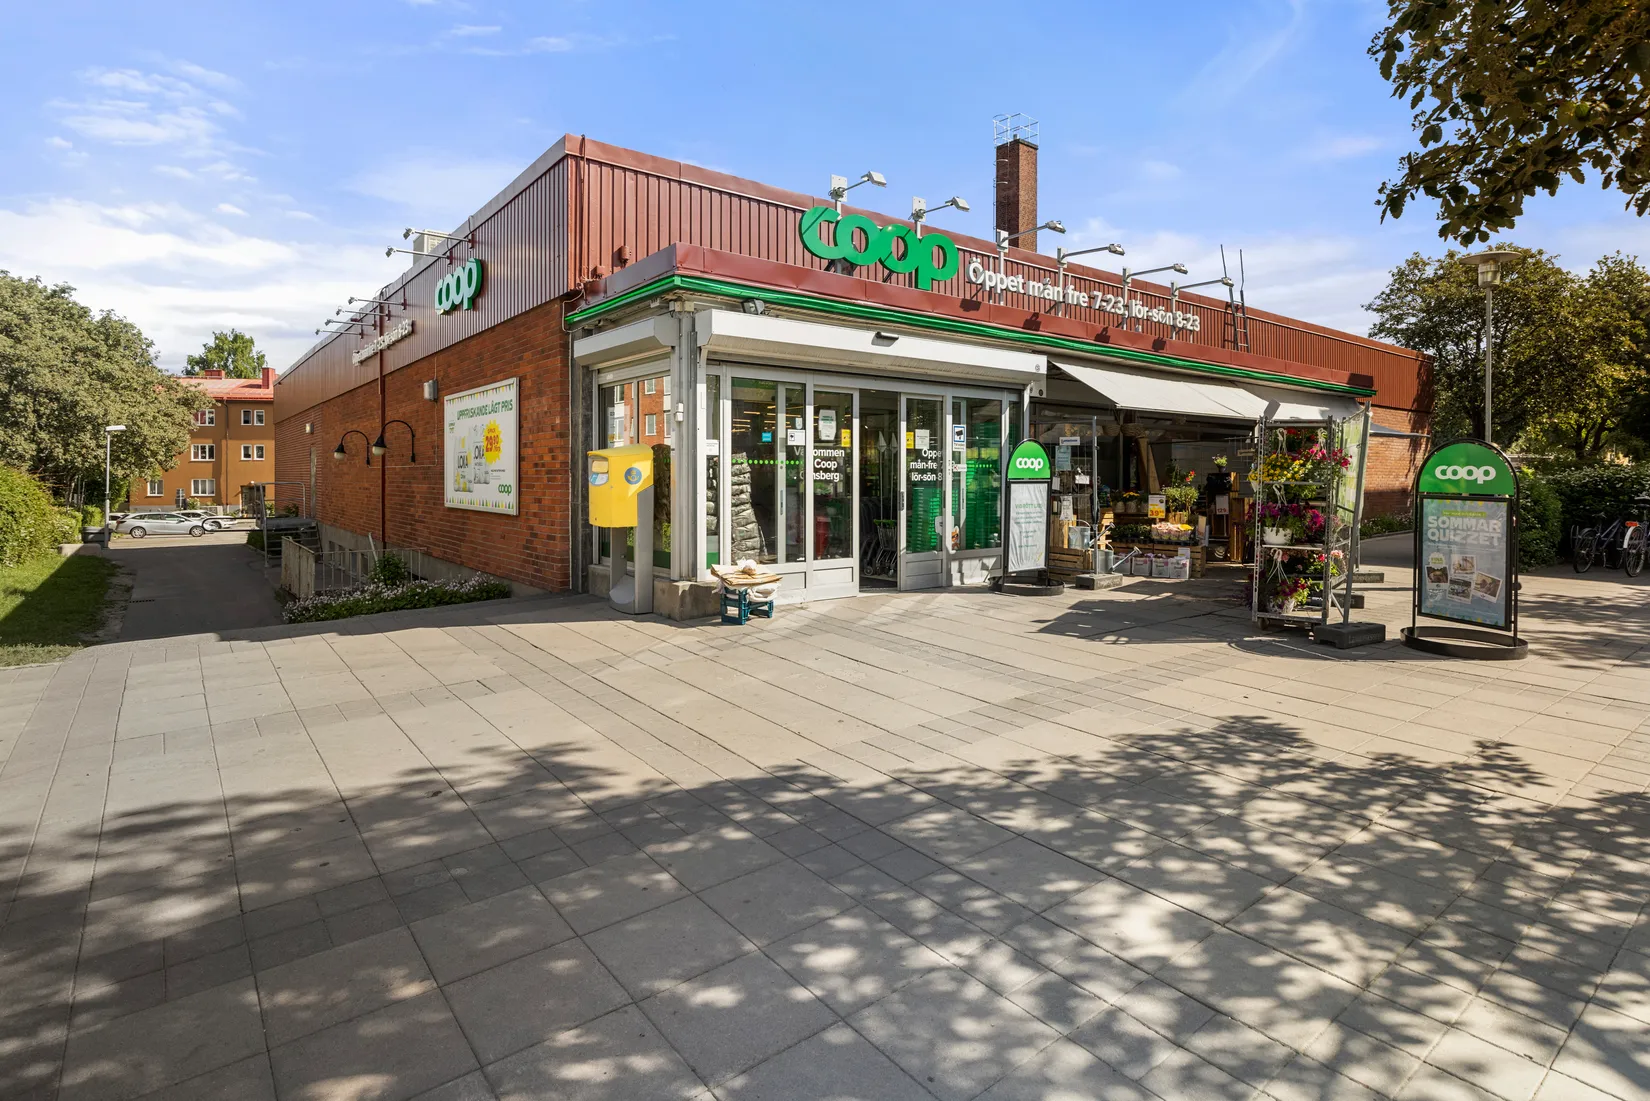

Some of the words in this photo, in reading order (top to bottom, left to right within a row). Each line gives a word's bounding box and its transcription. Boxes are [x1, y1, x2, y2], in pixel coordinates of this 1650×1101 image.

[799, 206, 959, 291] coop
[435, 257, 482, 315] coop
[966, 256, 1024, 294] Öppet
[1091, 290, 1128, 318] 7-23,
[1129, 299, 1173, 326] lör-sön
[1173, 310, 1200, 332] 8-23
[502, 399, 513, 412] PRIS
[814, 458, 838, 471] Coop
[910, 459, 938, 469] mån-fre
[1016, 458, 1044, 471] coop
[911, 471, 937, 481] lör-sön
[1435, 465, 1496, 484] coop
[498, 484, 513, 496] coop
[1427, 515, 1502, 533] SOMMAR
[1427, 528, 1502, 546] QUIZZET
